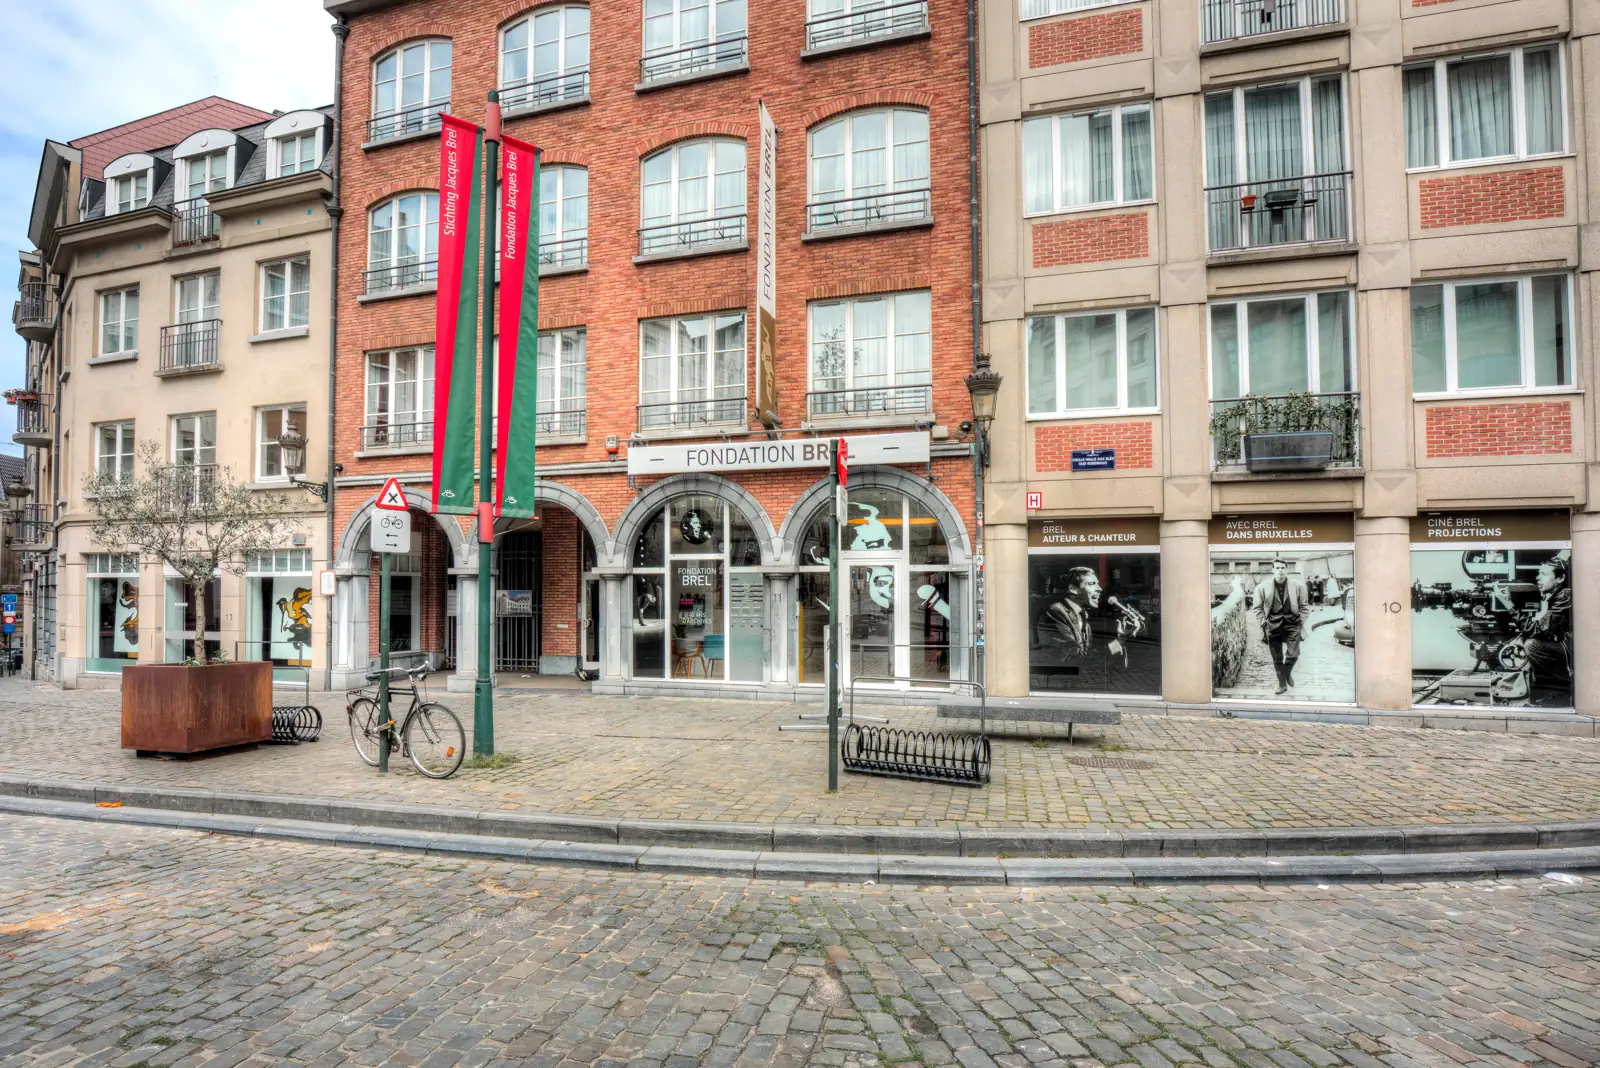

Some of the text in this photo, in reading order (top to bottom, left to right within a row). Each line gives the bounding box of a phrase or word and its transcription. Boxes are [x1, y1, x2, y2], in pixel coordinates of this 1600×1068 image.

[443, 127, 460, 236] Stichting Jacques Brel
[505, 150, 519, 259] Fondation Jacques Brel
[762, 126, 772, 300] FONDATION BREL
[686, 445, 795, 467] FONDATION
[1030, 495, 1039, 506] H
[1226, 520, 1278, 529] AVEC BREL
[1427, 516, 1484, 527] CINÉ BREL
[1043, 525, 1065, 534] BREL
[1226, 530, 1313, 539] DANS BRUXELLES
[1428, 528, 1502, 537] PROJECTIONS
[1042, 533, 1136, 543] AUTEUR & CHANTEUR
[677, 567, 717, 575] FONDATION
[682, 575, 712, 586] BREL
[774, 593, 782, 603] 11
[1382, 601, 1402, 613] 10
